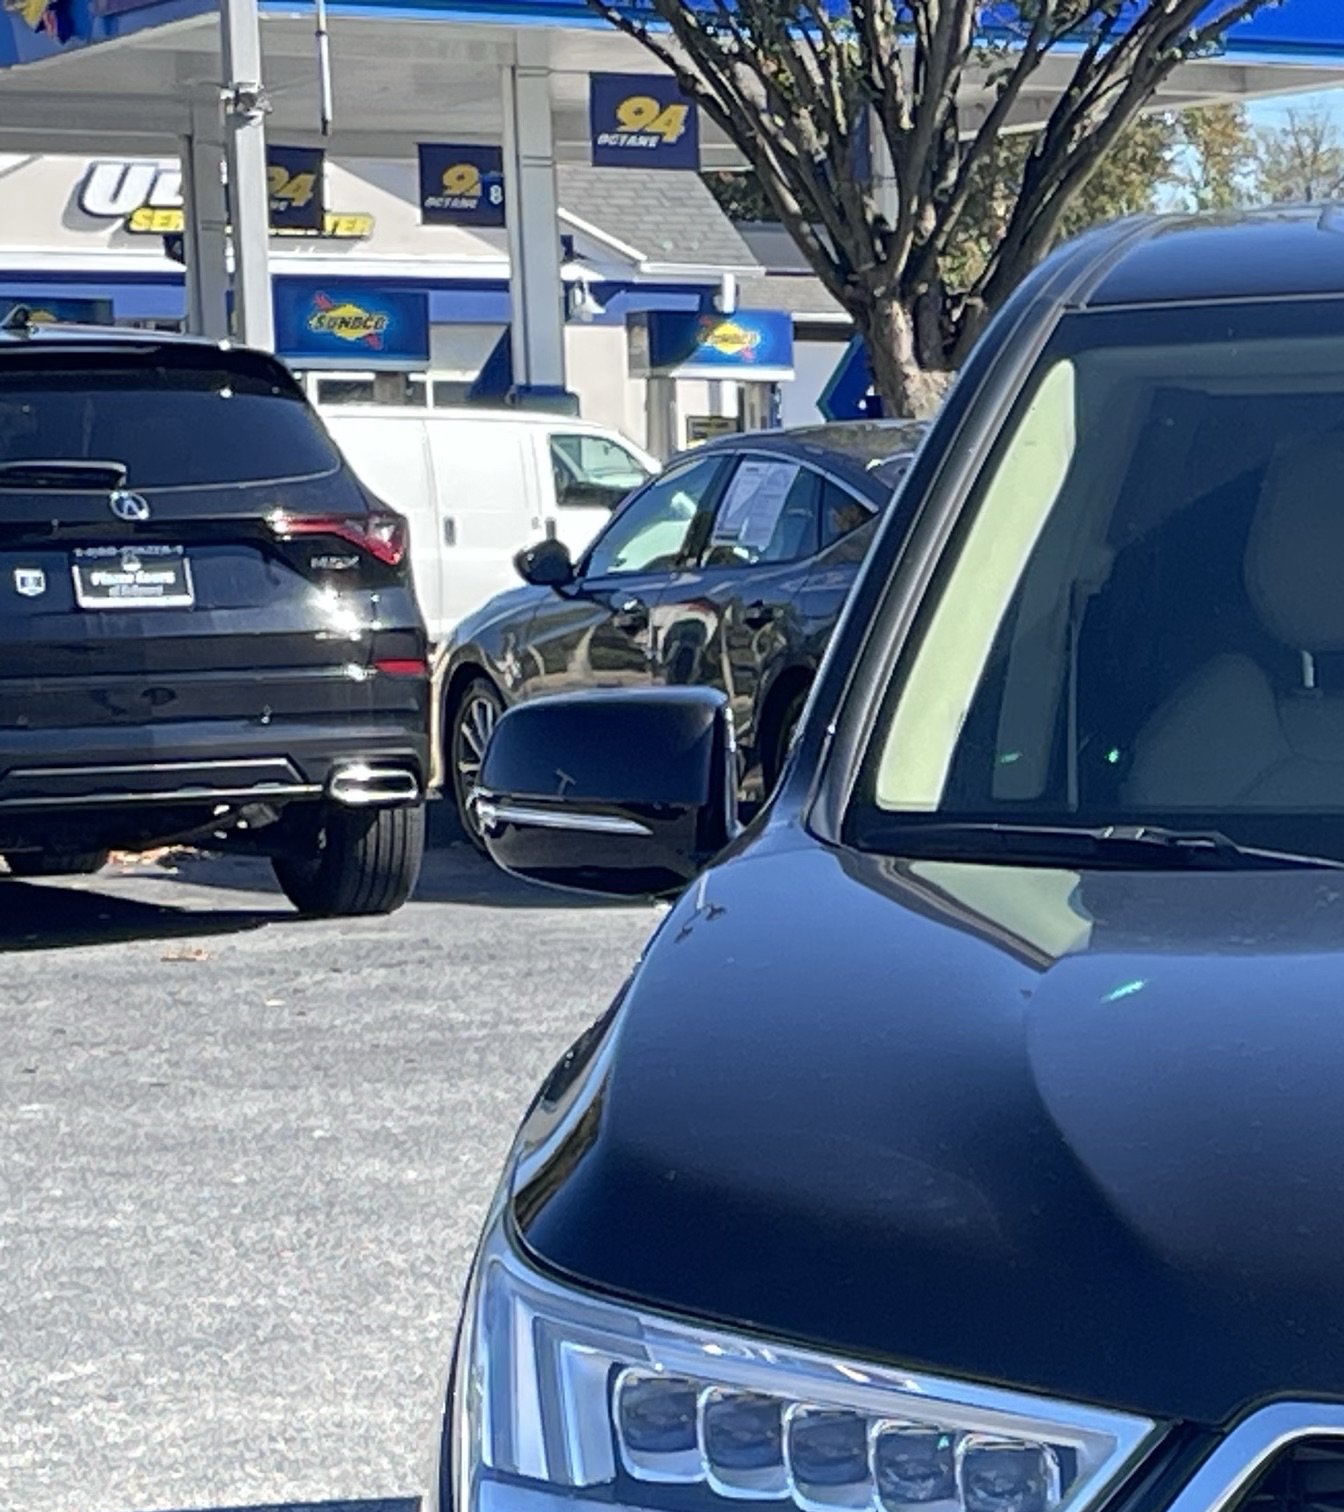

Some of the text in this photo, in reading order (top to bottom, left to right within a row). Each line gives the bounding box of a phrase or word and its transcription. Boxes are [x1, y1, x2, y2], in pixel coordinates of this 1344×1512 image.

[615, 95, 690, 143] 94
[597, 132, 659, 148] OCTANE
[311, 312, 388, 332] SUNOCO
